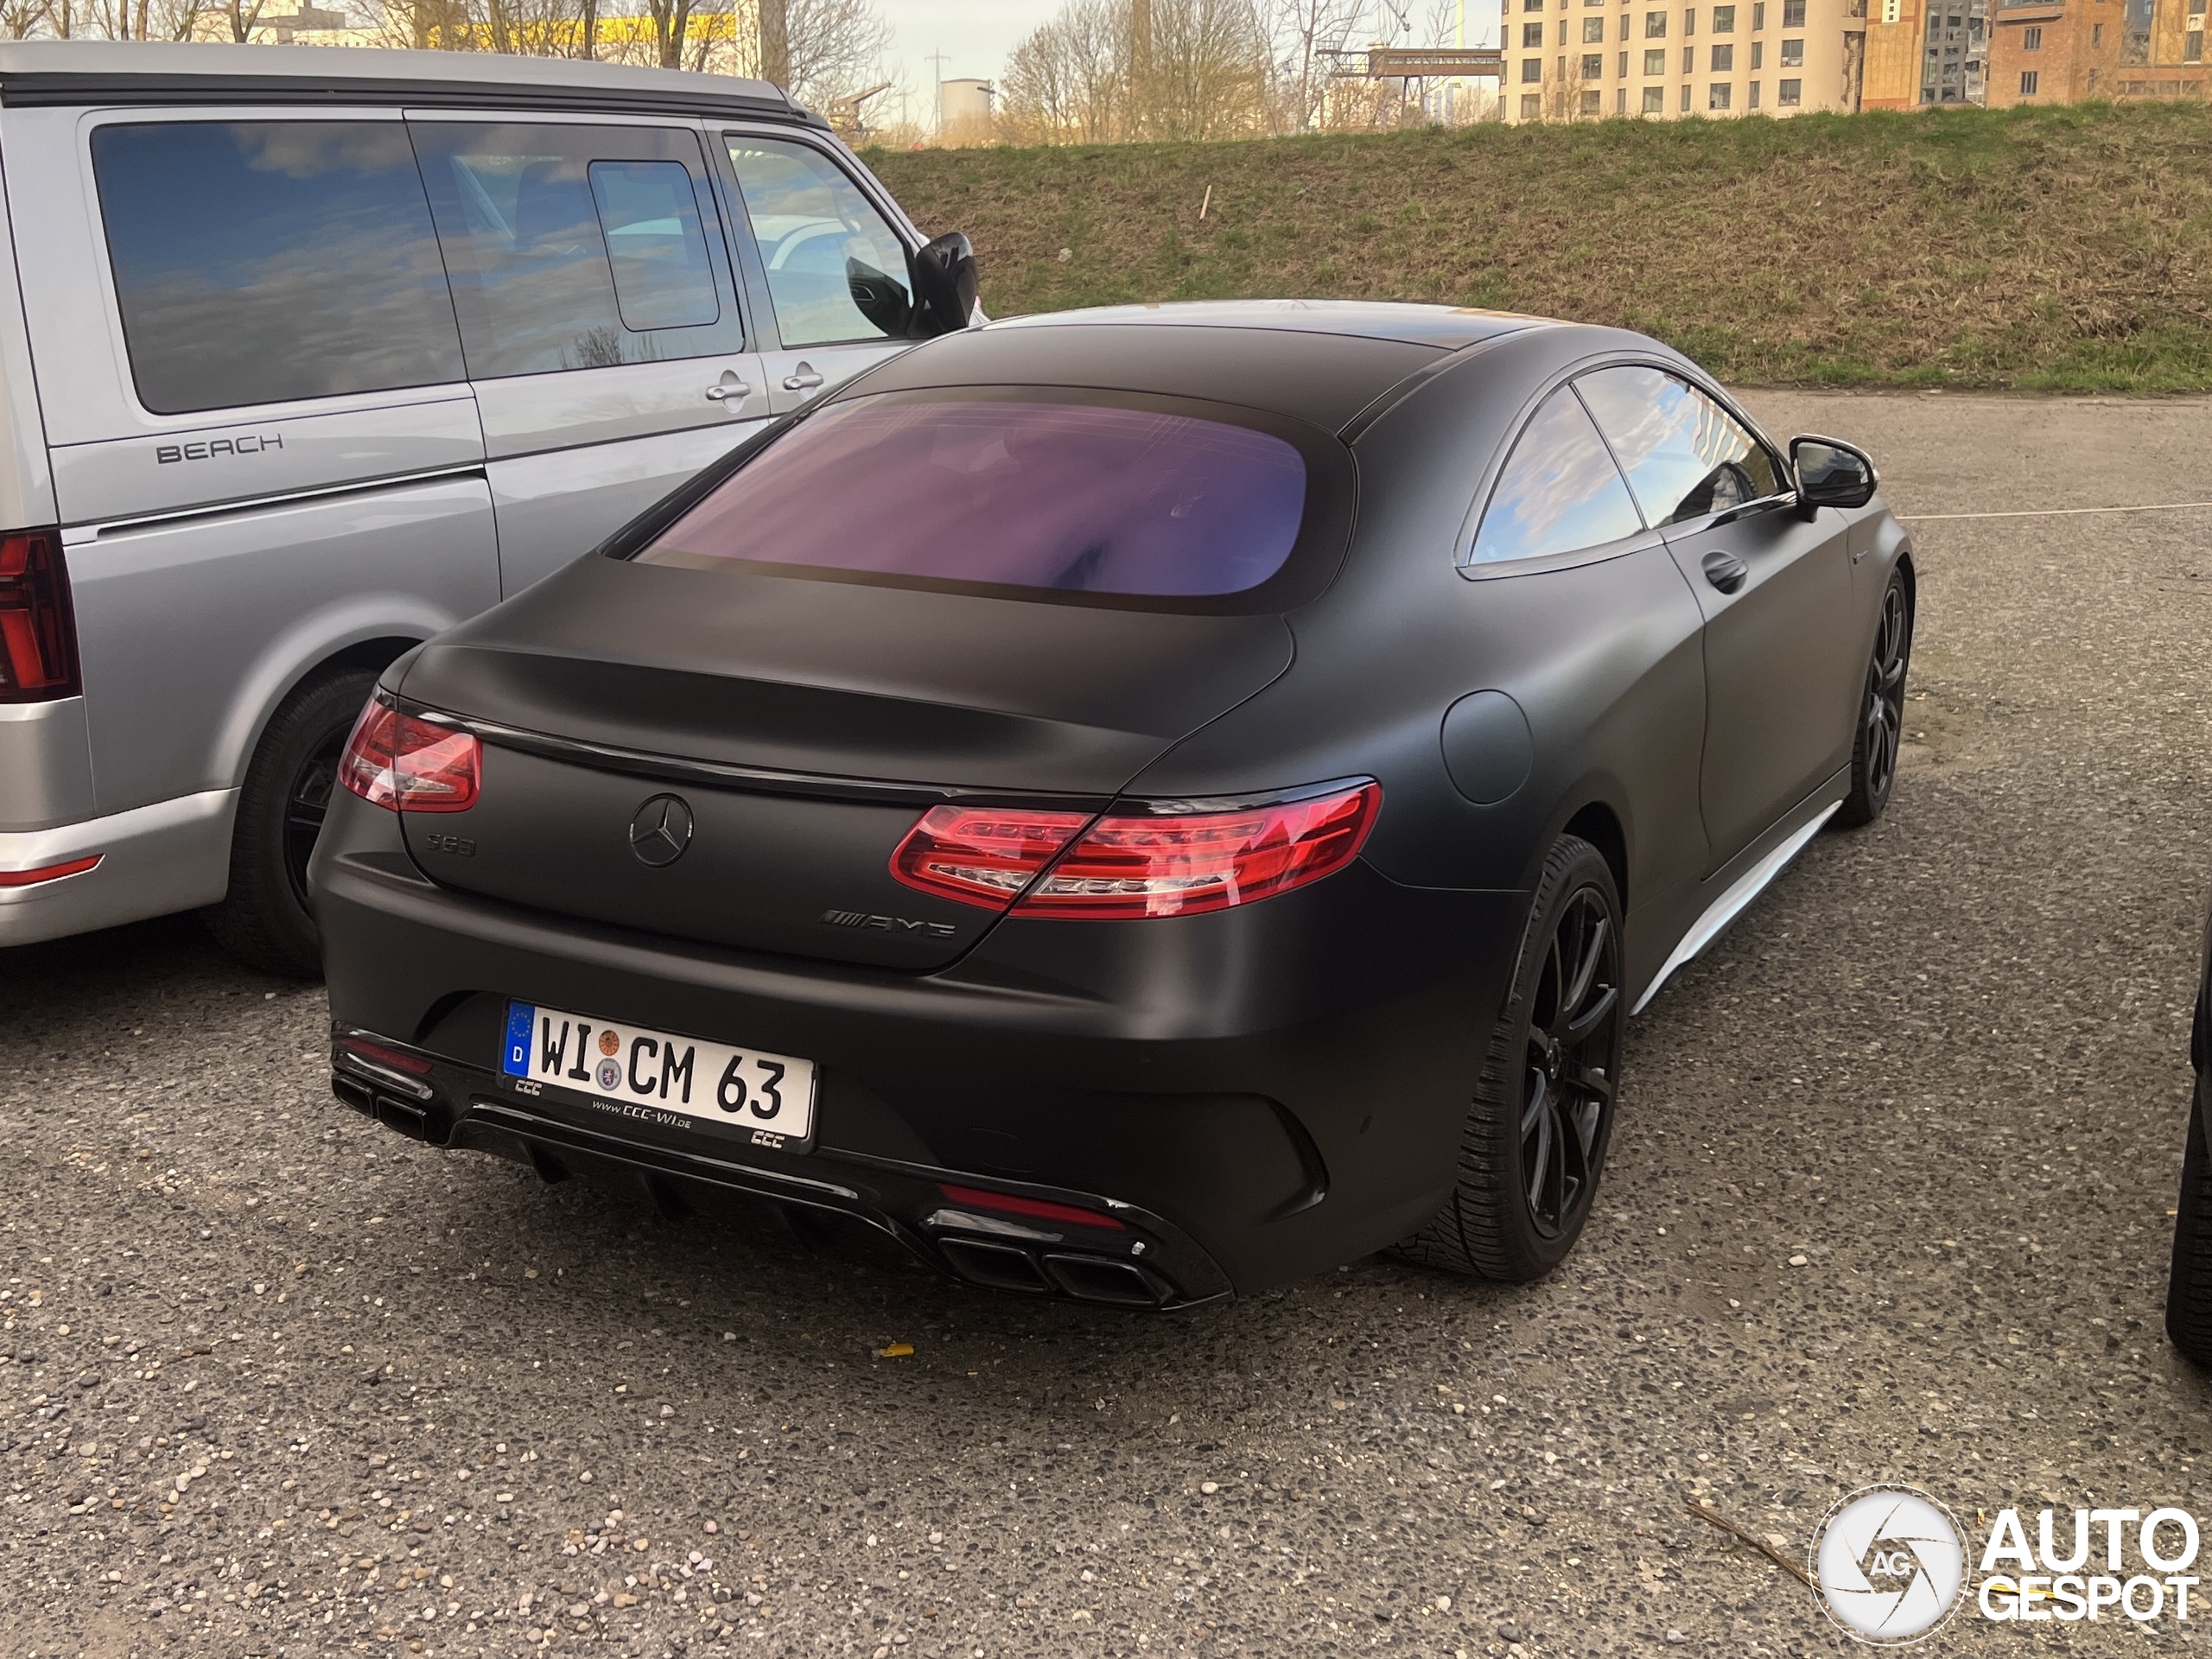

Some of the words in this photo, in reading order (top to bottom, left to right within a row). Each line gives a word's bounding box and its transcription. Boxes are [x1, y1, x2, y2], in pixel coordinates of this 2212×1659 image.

[156, 433, 283, 464] BEACH
[426, 833, 477, 858] S63
[512, 1046, 523, 1063] D
[542, 1017, 591, 1082] WI
[628, 1037, 695, 1103] CM
[717, 1055, 785, 1120] 63
